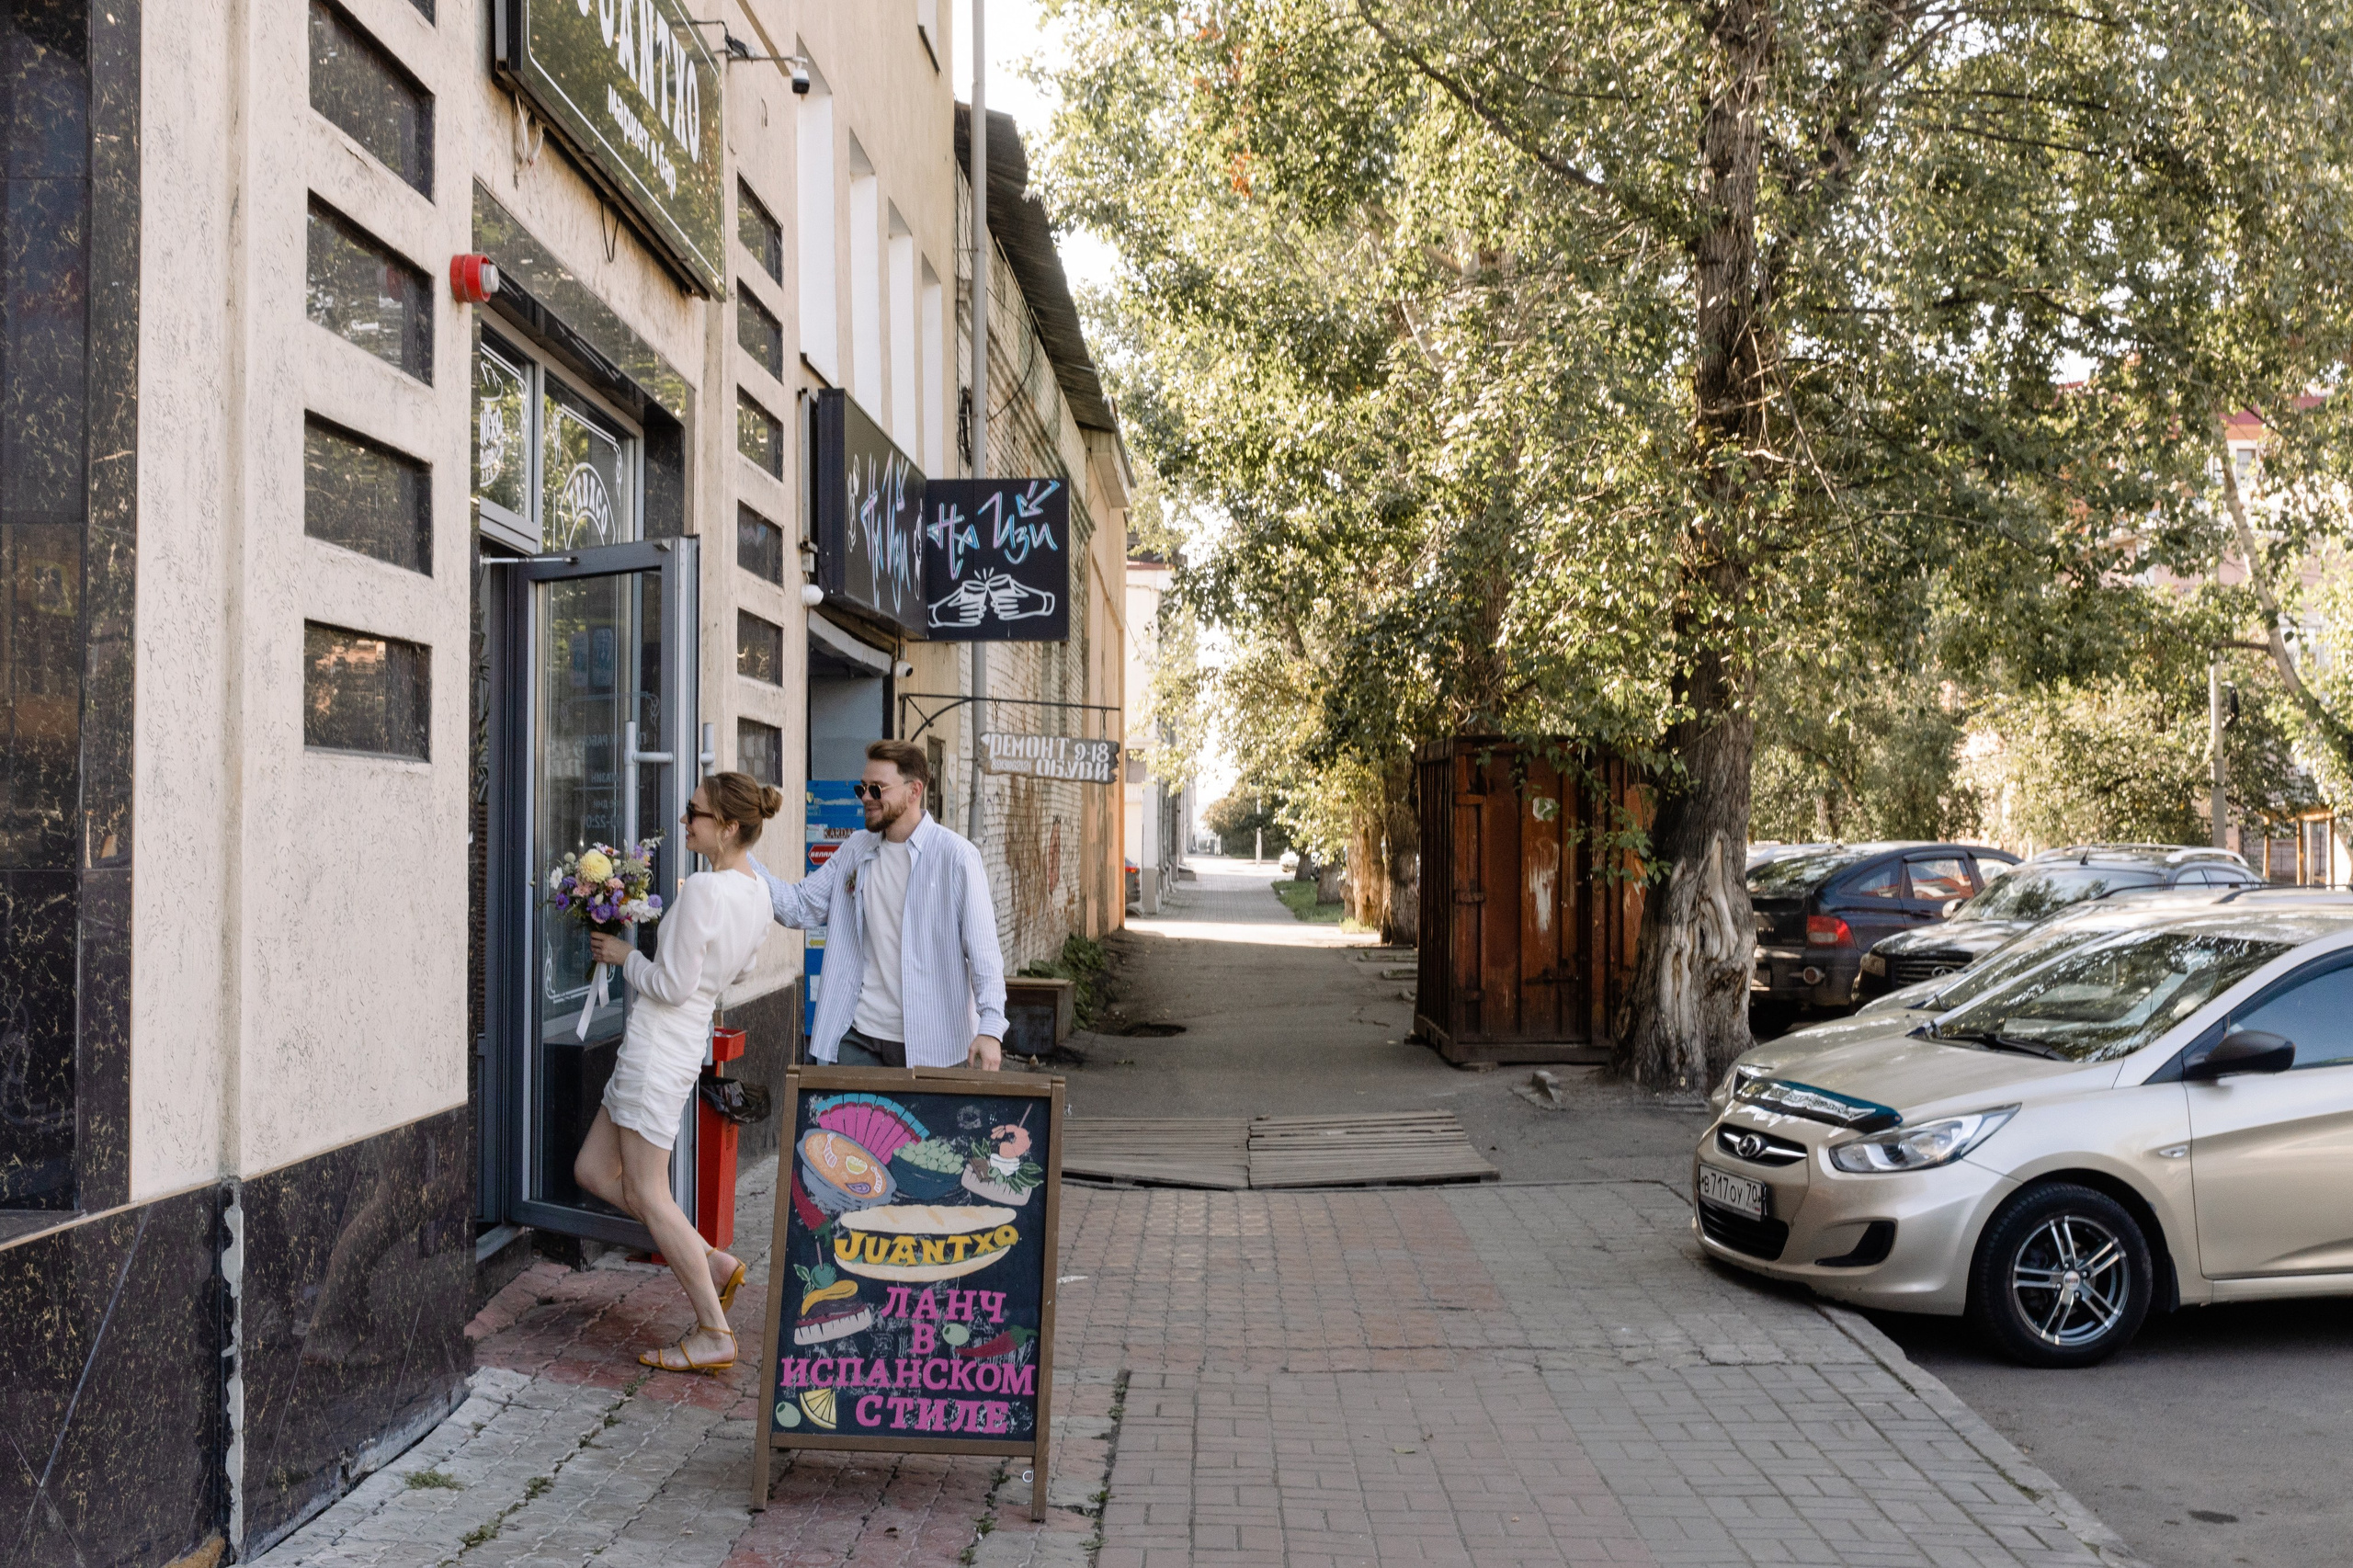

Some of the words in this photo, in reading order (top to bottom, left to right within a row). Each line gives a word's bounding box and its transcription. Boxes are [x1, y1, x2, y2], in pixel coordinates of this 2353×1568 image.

[577, 0, 699, 164] ANTXO
[658, 141, 676, 200] бар
[568, 472, 608, 535] TABACO
[990, 733, 1069, 760] РЕМОНТ
[1036, 758, 1108, 781] ОБУВИ
[823, 827, 858, 840] KARDA
[834, 1224, 1020, 1267] JUANTXO
[880, 1287, 1007, 1324] ЛАНЧ
[908, 1324, 937, 1356] В
[779, 1357, 1036, 1396] ИСПАНСКОМ
[855, 1393, 1010, 1435] СТИЛЕ
